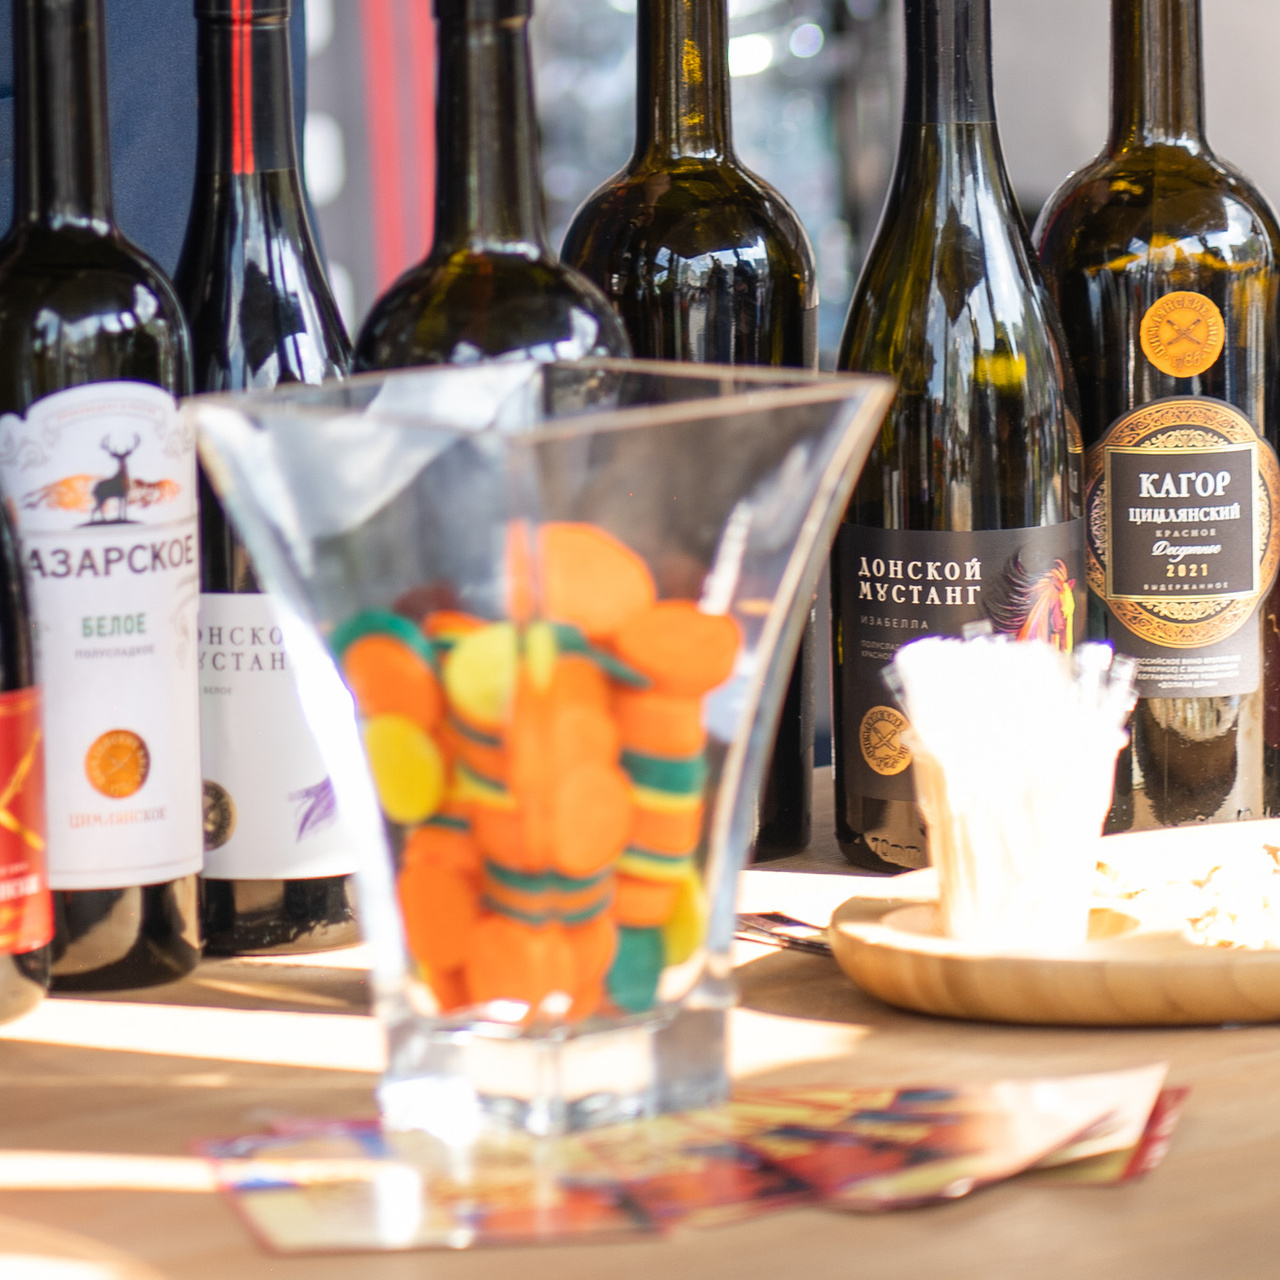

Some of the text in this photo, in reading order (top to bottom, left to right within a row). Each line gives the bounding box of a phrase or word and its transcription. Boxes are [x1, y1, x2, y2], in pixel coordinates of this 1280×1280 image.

[1138, 471, 1231, 498] КАГОР
[1128, 502, 1240, 525] ЦИМЛЯНСКИЙ
[1155, 528, 1217, 538] КРАСНОЕ
[858, 557, 982, 581] ДОНСКОЙ
[1166, 564, 1208, 577] 2021
[1143, 582, 1229, 591] ВЫДЕРЖАННОЕ
[82, 612, 147, 638] БЕЛОЕ
[860, 616, 929, 630] ИЗАБЕЛЛА
[75, 645, 155, 659] ПОЛУСЛАДКОЕ
